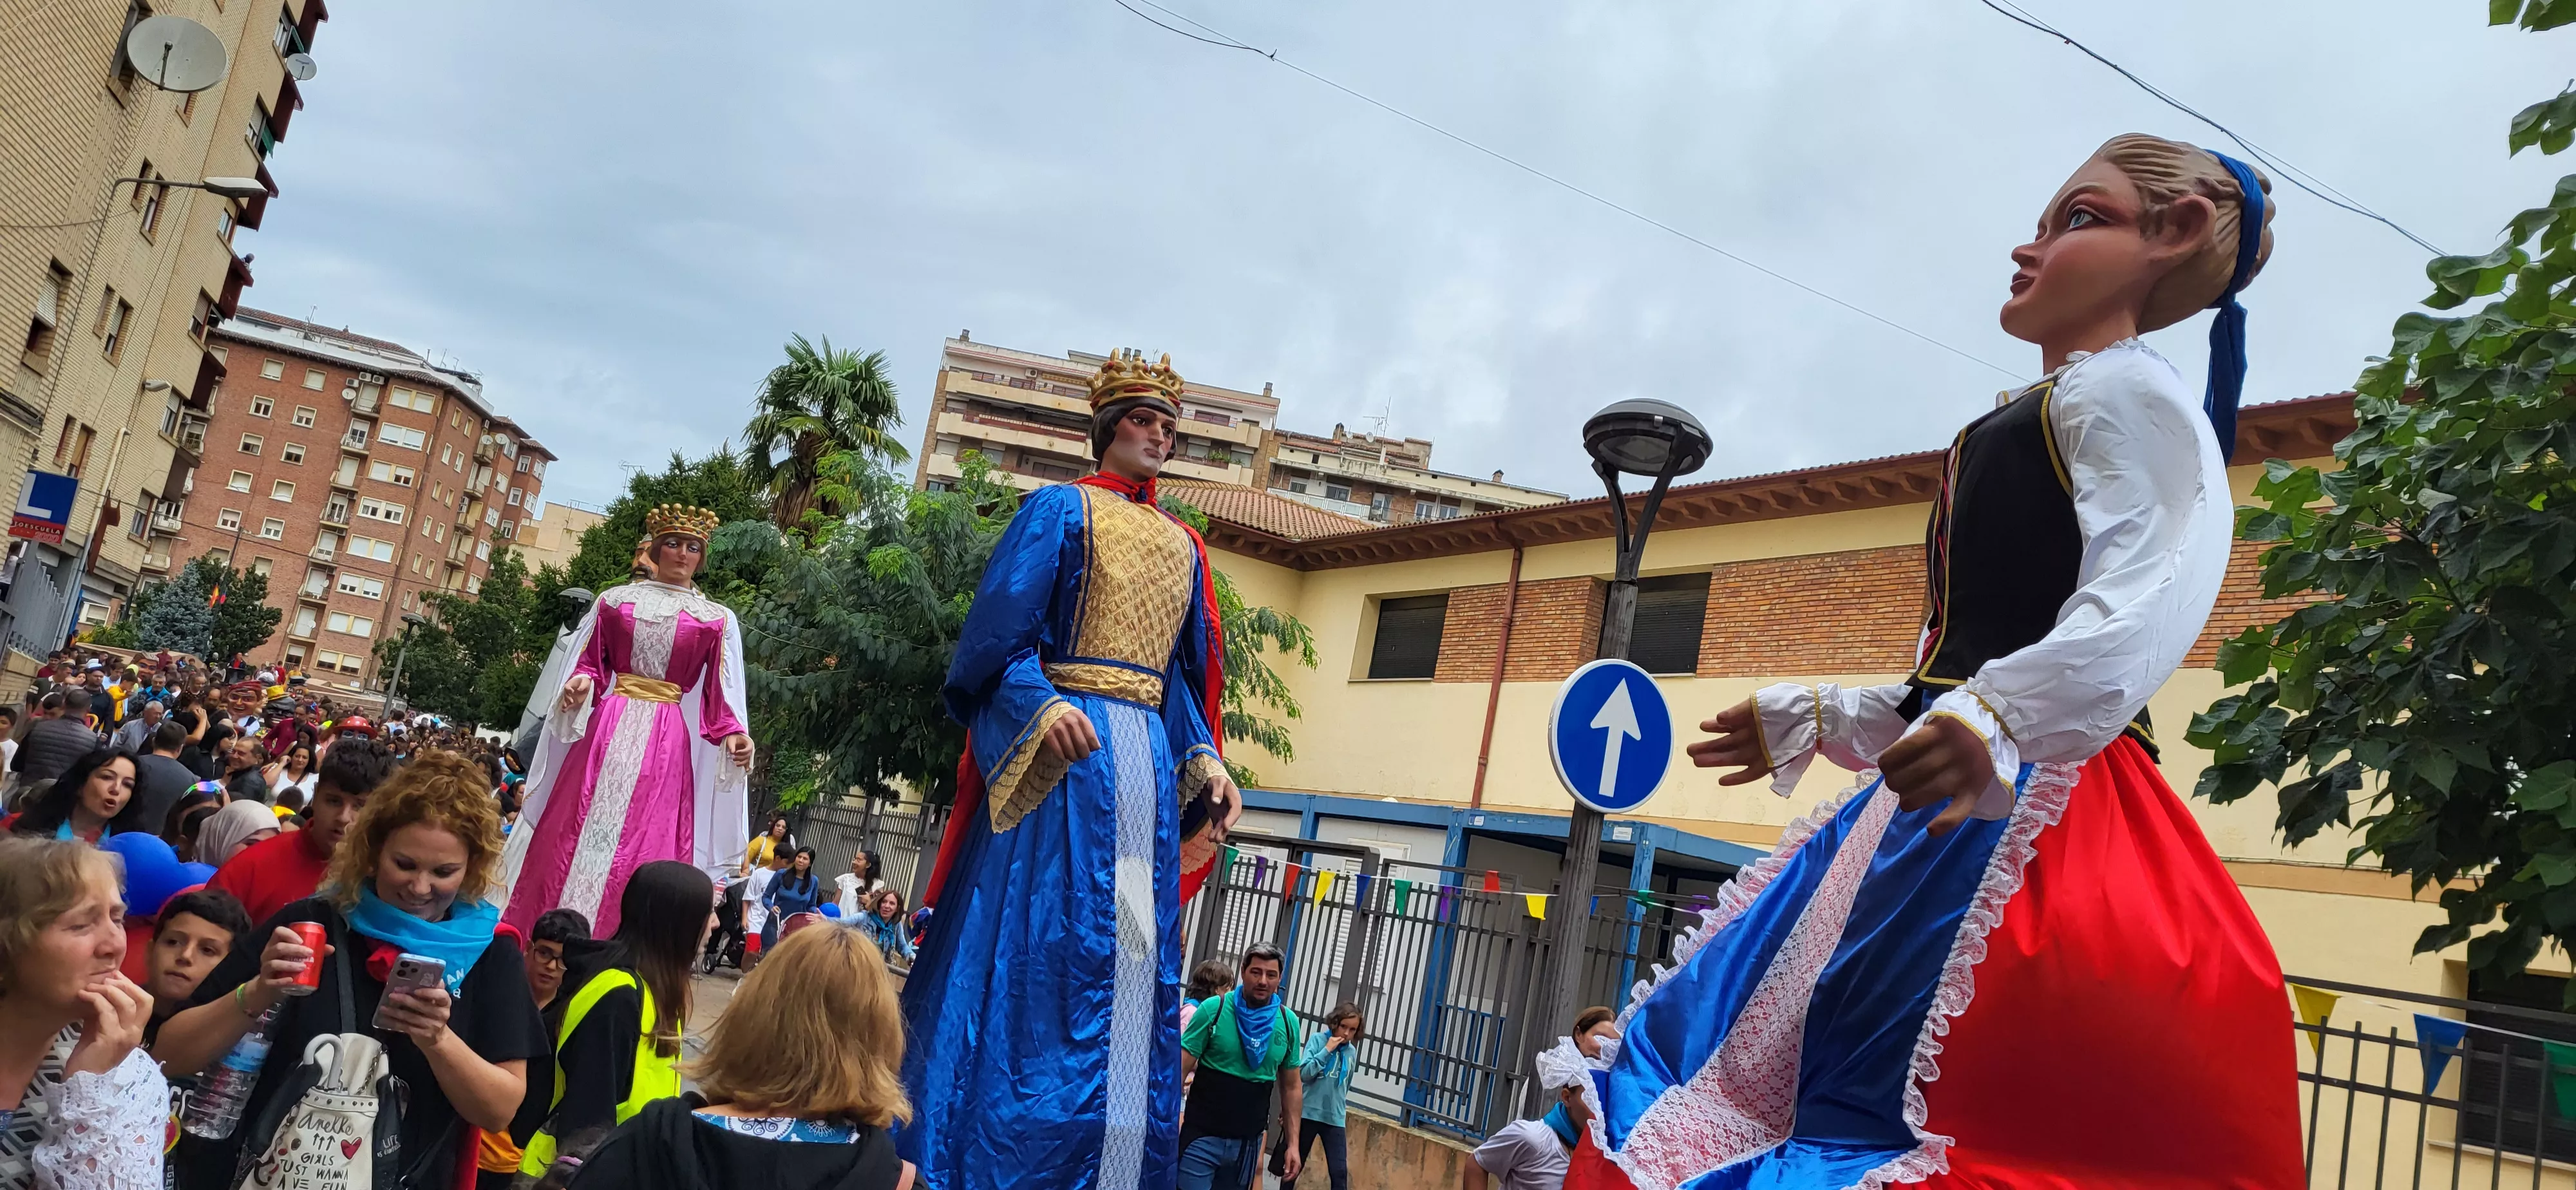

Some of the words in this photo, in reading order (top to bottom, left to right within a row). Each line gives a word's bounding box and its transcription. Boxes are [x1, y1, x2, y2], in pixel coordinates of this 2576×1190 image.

[15, 472, 52, 519] L
[277, 1174, 310, 1190] AVE
[316, 1168, 348, 1180] WANNA
